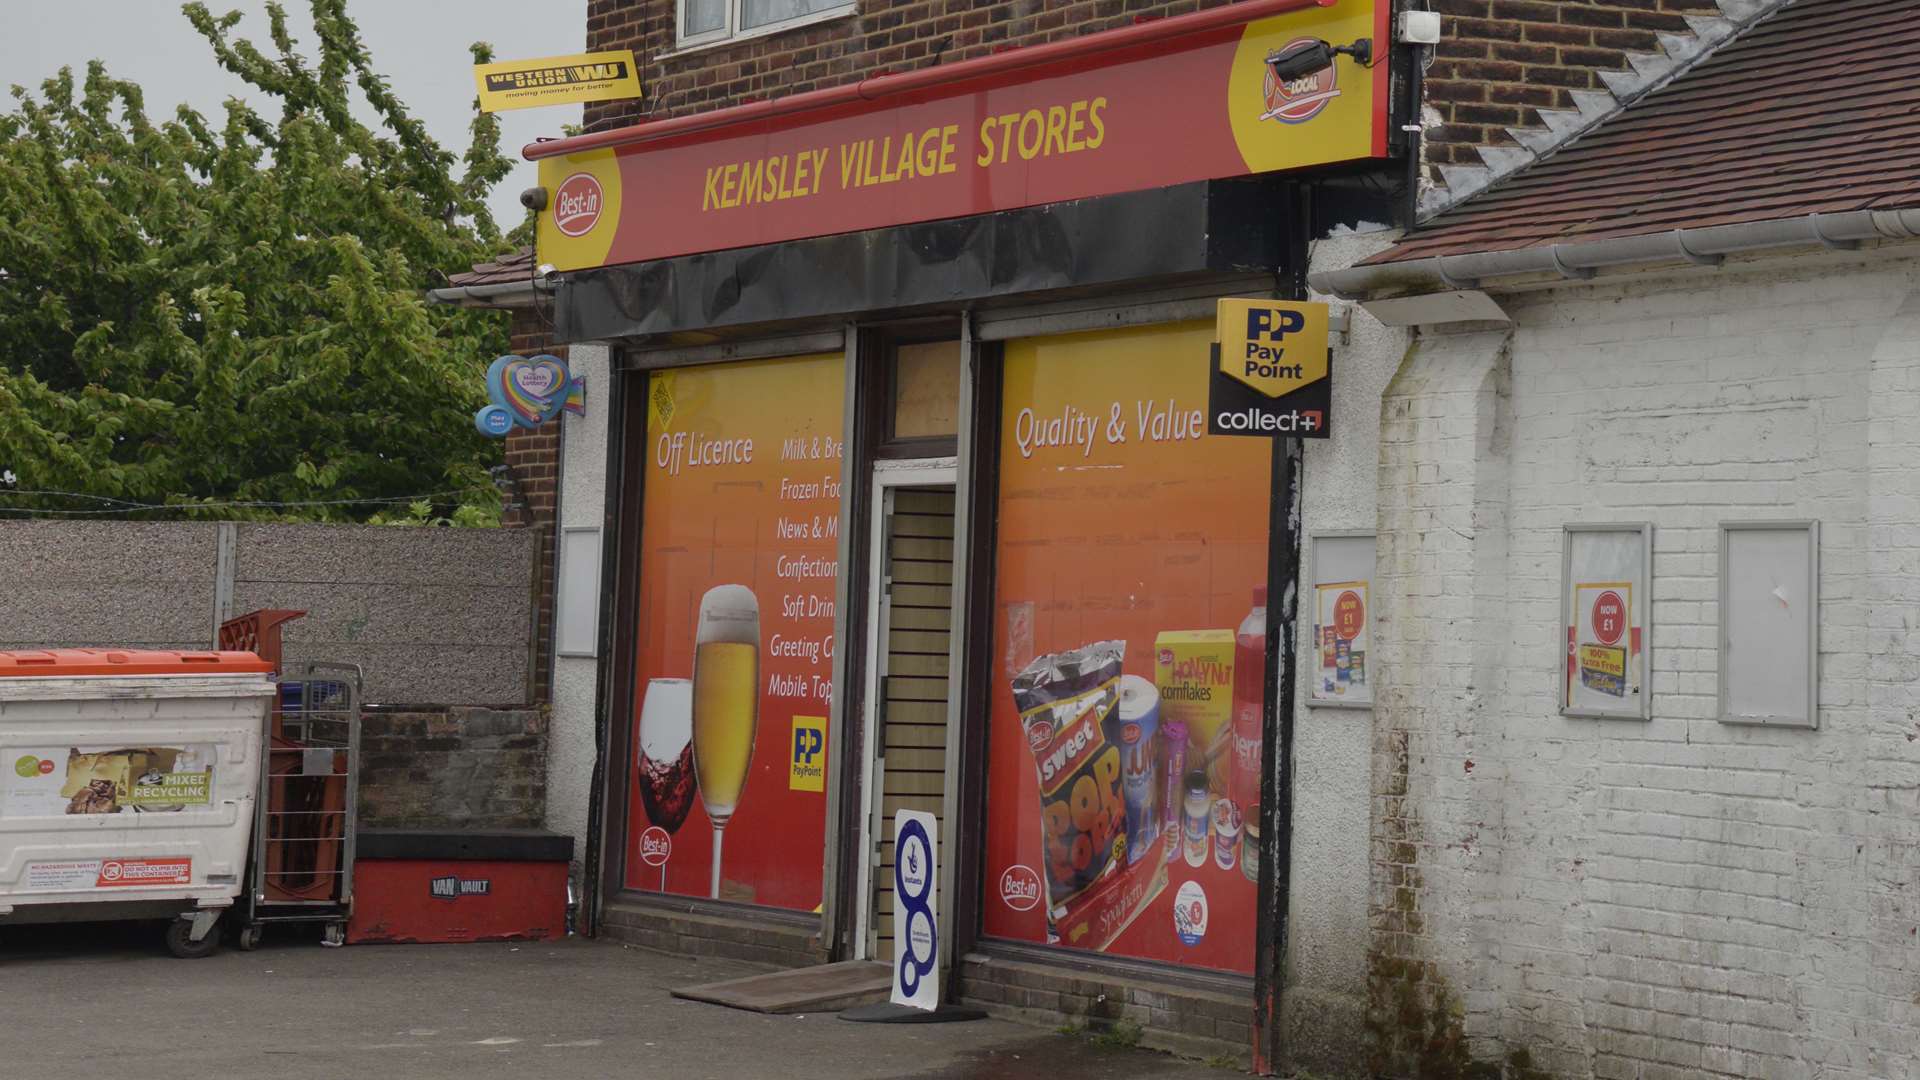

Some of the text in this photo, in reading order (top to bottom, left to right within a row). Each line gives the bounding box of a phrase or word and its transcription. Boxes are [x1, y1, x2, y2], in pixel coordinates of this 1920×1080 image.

[490, 67, 566, 83] WESTERN
[515, 75, 568, 88] UNION
[573, 63, 619, 82] WU
[505, 82, 613, 99] moving money for better
[1290, 74, 1319, 95] LOCAL
[702, 96, 1107, 211] KEMSLEY VILLAGE STORES
[560, 187, 597, 217] Best-in
[1246, 342, 1284, 364] Pay
[1245, 360, 1303, 379] Point
[1015, 398, 1202, 458] Quality & Value
[1217, 408, 1316, 431] collect+
[657, 431, 753, 477] Off Licence
[781, 437, 807, 463] Milk
[810, 436, 820, 459] &
[780, 477, 818, 500] Frozen
[777, 517, 808, 539] News
[812, 515, 821, 539] &
[782, 593, 836, 622] Soft Drin
[1600, 605, 1617, 615] NOW
[1603, 618, 1614, 631] £1
[770, 633, 819, 665] Greeting
[768, 673, 807, 697] Mobile
[1161, 681, 1212, 701] cornflakes
[1042, 719, 1094, 780] sweet
[165, 774, 205, 786] MIXED
[792, 764, 822, 778] PayPoint
[133, 786, 205, 798] RECYCLING
[432, 877, 455, 896] VAN
[460, 880, 489, 893] VAULT
[1005, 874, 1037, 896] Best-in
